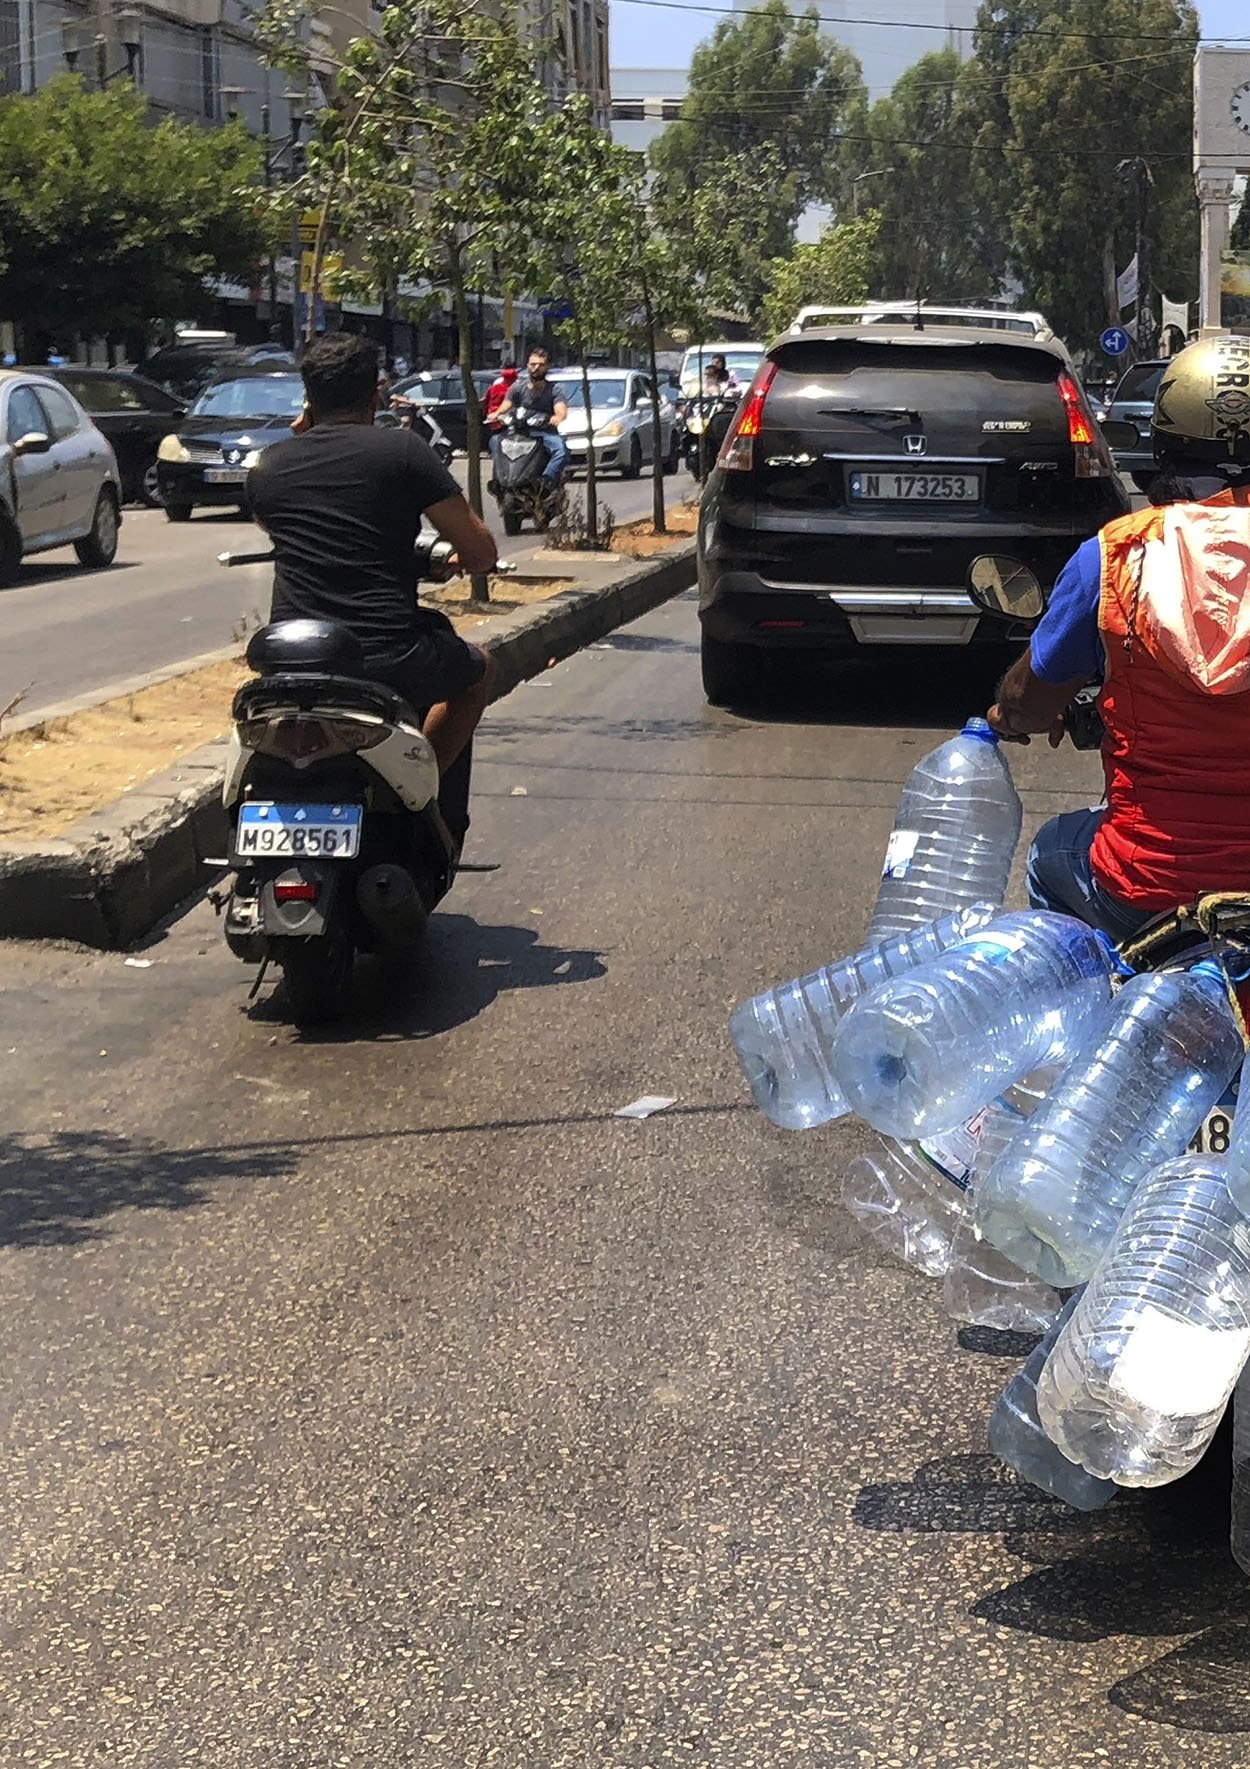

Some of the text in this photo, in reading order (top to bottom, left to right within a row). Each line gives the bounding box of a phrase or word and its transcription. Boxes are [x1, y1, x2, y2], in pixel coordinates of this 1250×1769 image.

[866, 475, 966, 498] N 173253
[242, 828, 352, 853] M928561
